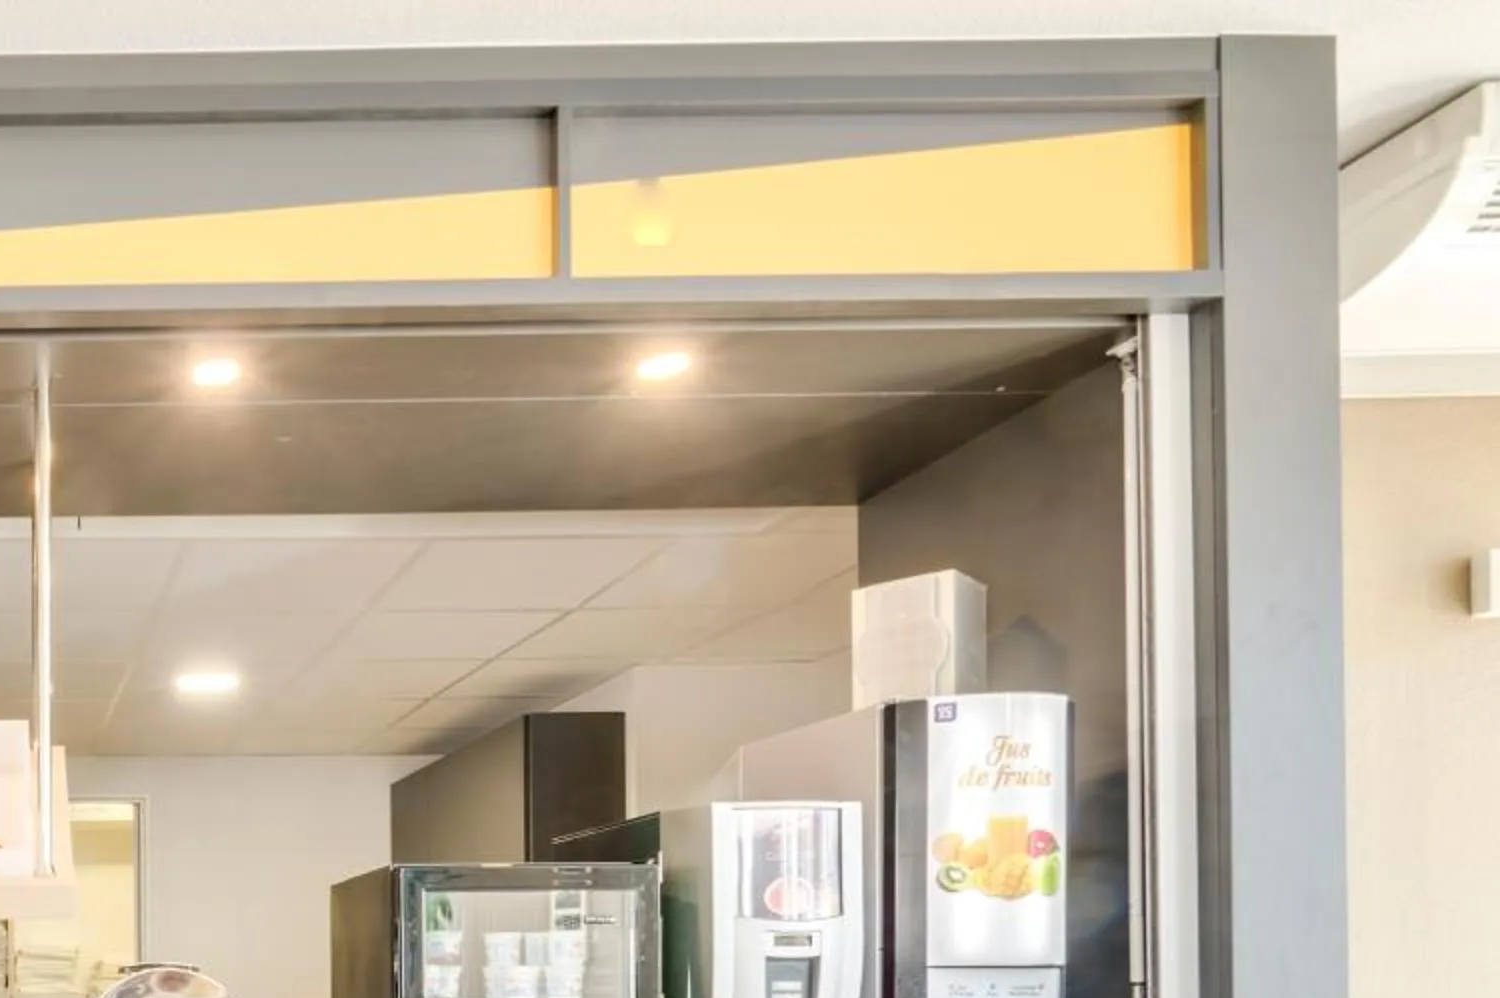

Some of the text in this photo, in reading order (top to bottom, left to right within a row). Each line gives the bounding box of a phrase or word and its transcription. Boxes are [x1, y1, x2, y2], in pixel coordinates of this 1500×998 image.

[985, 735, 1032, 766] Jus
[957, 763, 1053, 791] de fruits
